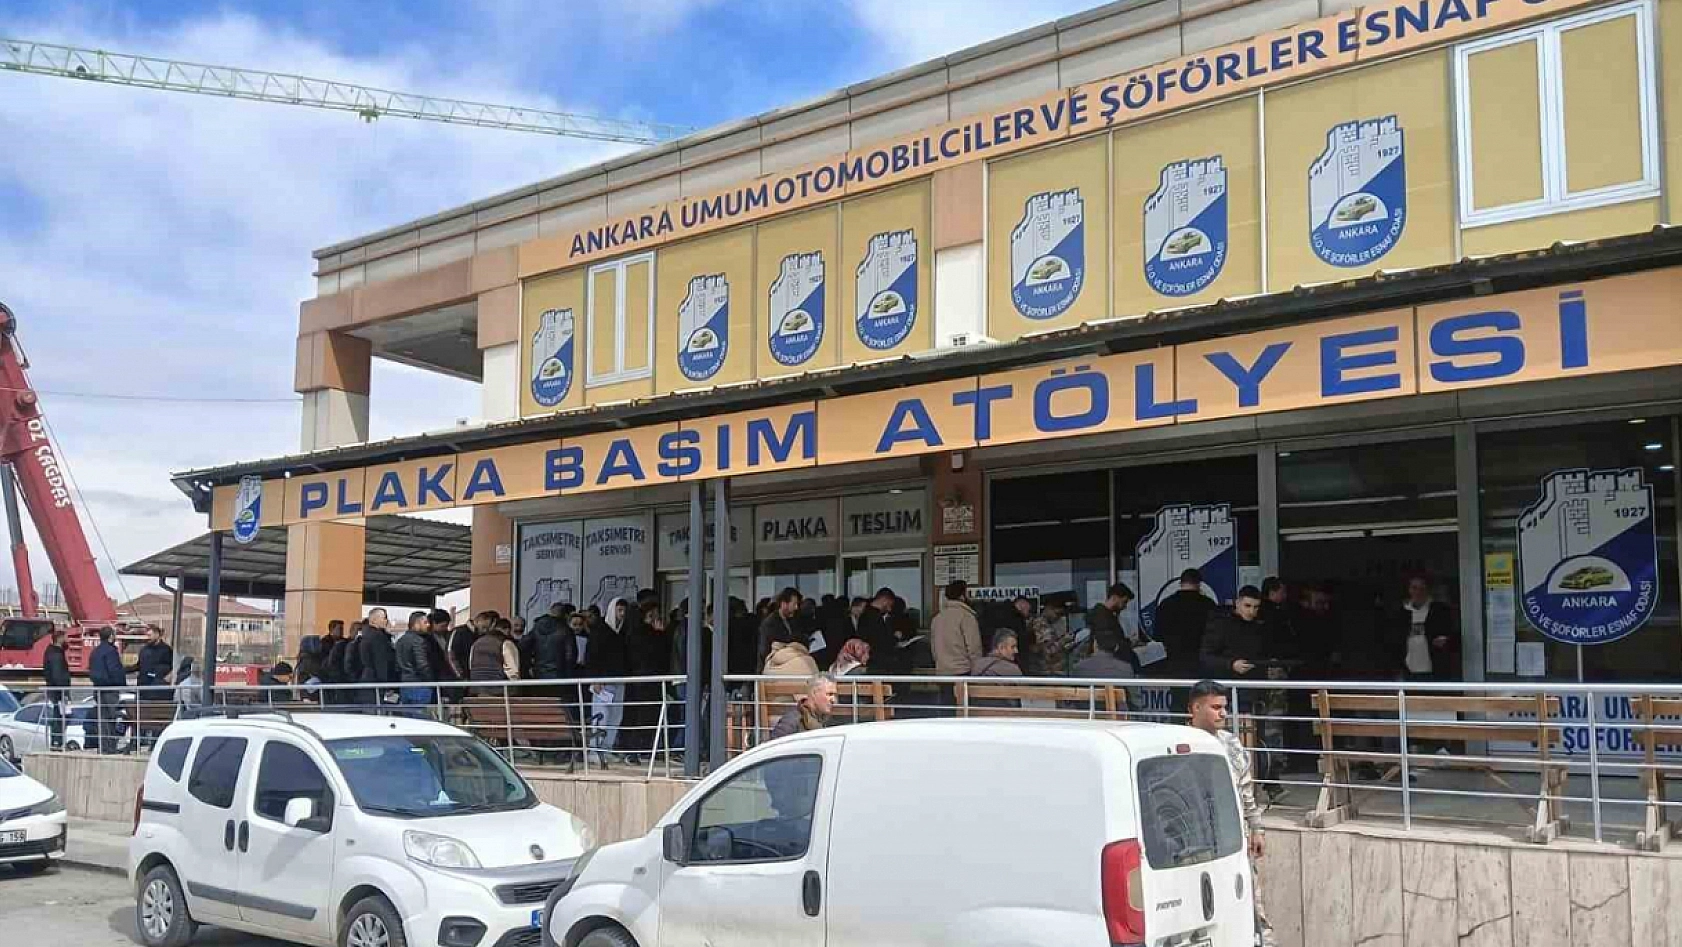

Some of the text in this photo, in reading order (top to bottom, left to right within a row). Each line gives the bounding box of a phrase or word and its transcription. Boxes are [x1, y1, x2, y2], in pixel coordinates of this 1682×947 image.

[569, 210, 674, 258] ANKARA
[1040, 94, 1088, 131] VE
[1100, 30, 1327, 124] ŞÖFÖRLER
[1337, 0, 1500, 53] ESNAF
[1377, 146, 1399, 158] 1927
[1338, 225, 1378, 239] ANKARA
[1169, 257, 1203, 271] ANKARA
[301, 290, 1590, 518] PLAKA BASIM ATÖLYESİ
[1613, 507, 1646, 519] 1927
[763, 516, 828, 541] PLAKA
[1207, 536, 1231, 547] 1927
[1561, 595, 1618, 608] ANKARA
[1539, 613, 1553, 629] VE
[1607, 610, 1639, 634] ESNAF
